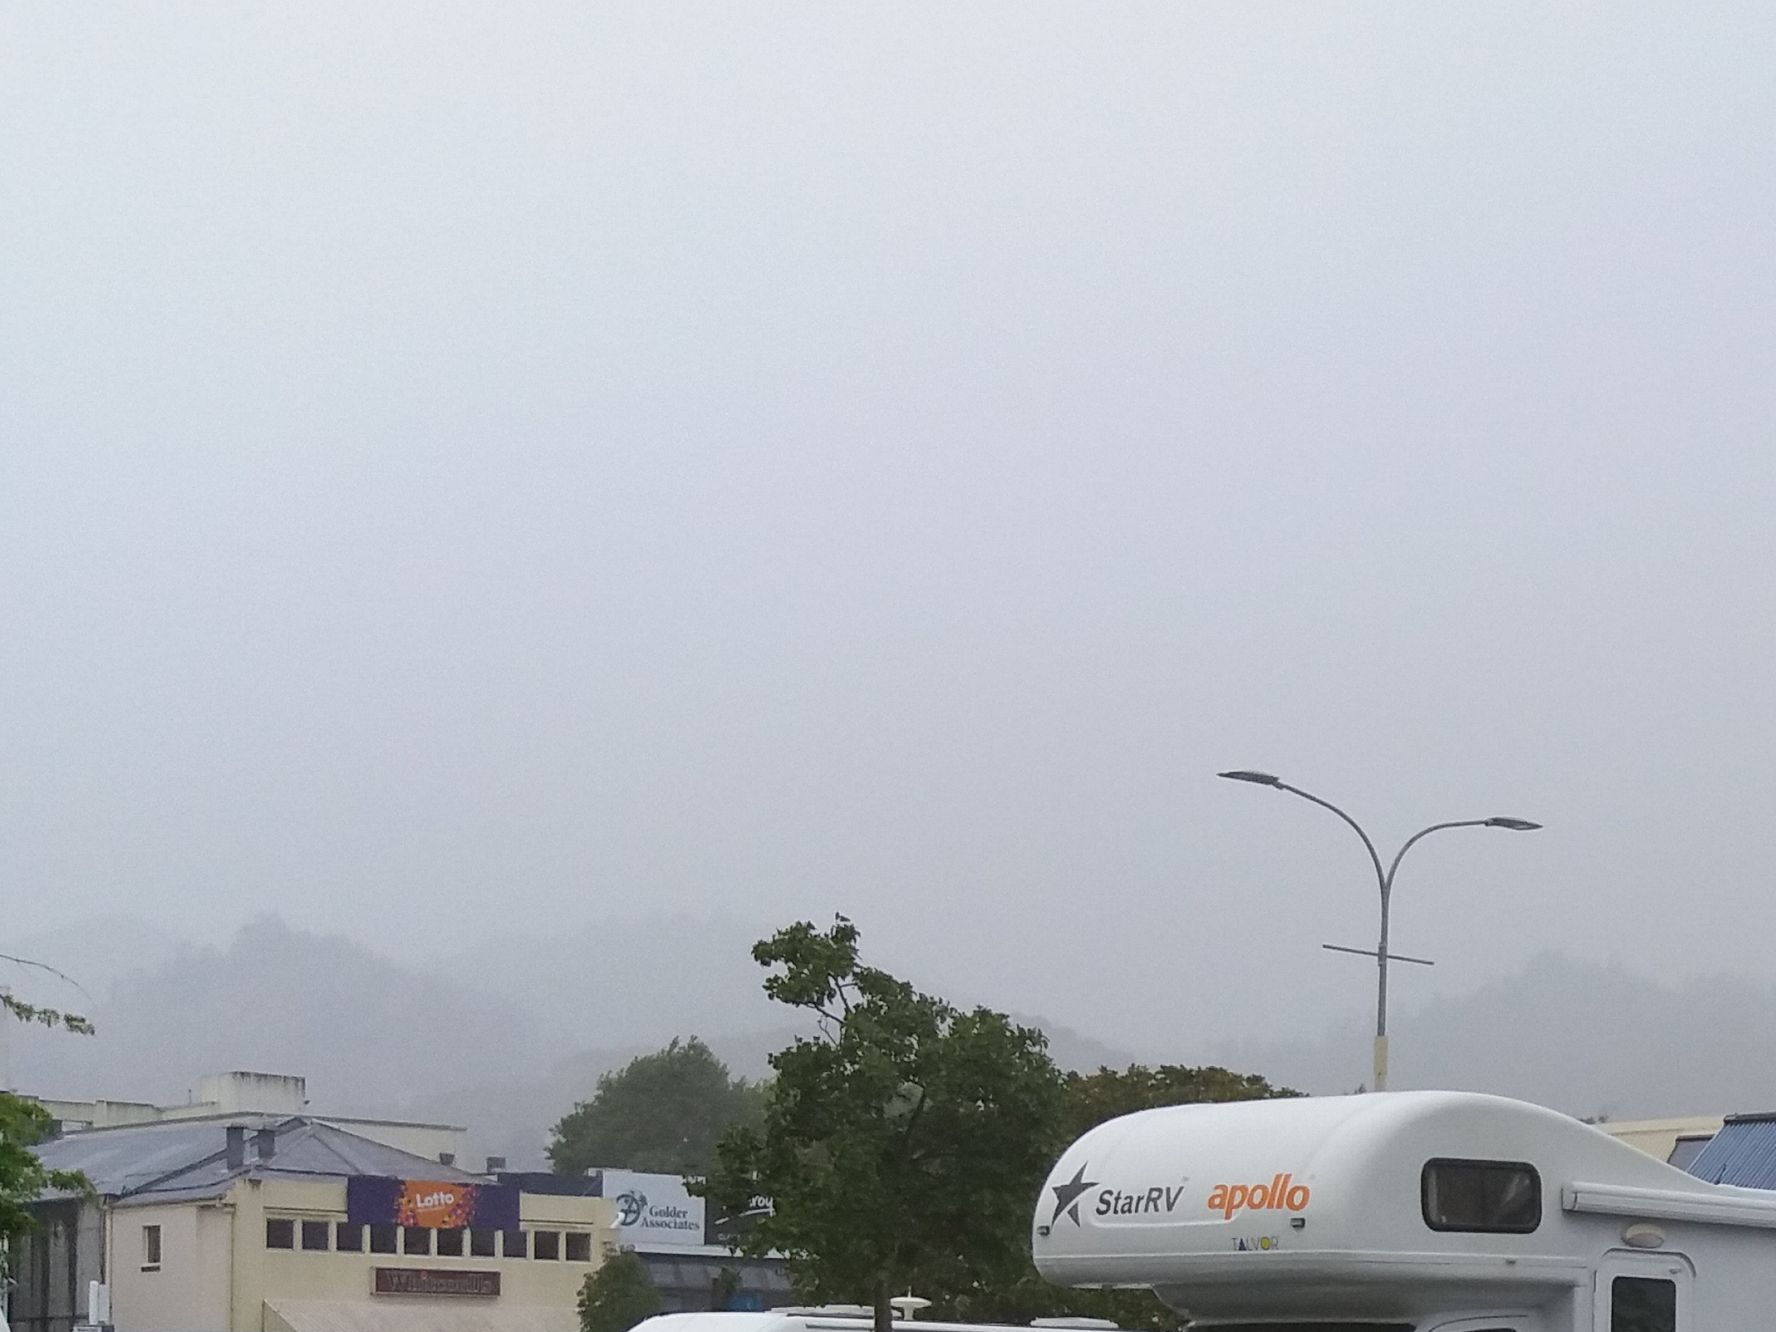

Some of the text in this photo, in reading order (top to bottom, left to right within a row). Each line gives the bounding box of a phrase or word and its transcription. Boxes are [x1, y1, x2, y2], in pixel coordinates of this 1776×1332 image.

[416, 1191, 454, 1208] Lotto
[1095, 1186, 1184, 1216] StarRV
[1207, 1173, 1310, 1221] apollo
[649, 1205, 688, 1219] Golder
[641, 1217, 700, 1231] Associates
[1231, 1236, 1280, 1251] TALVOR
